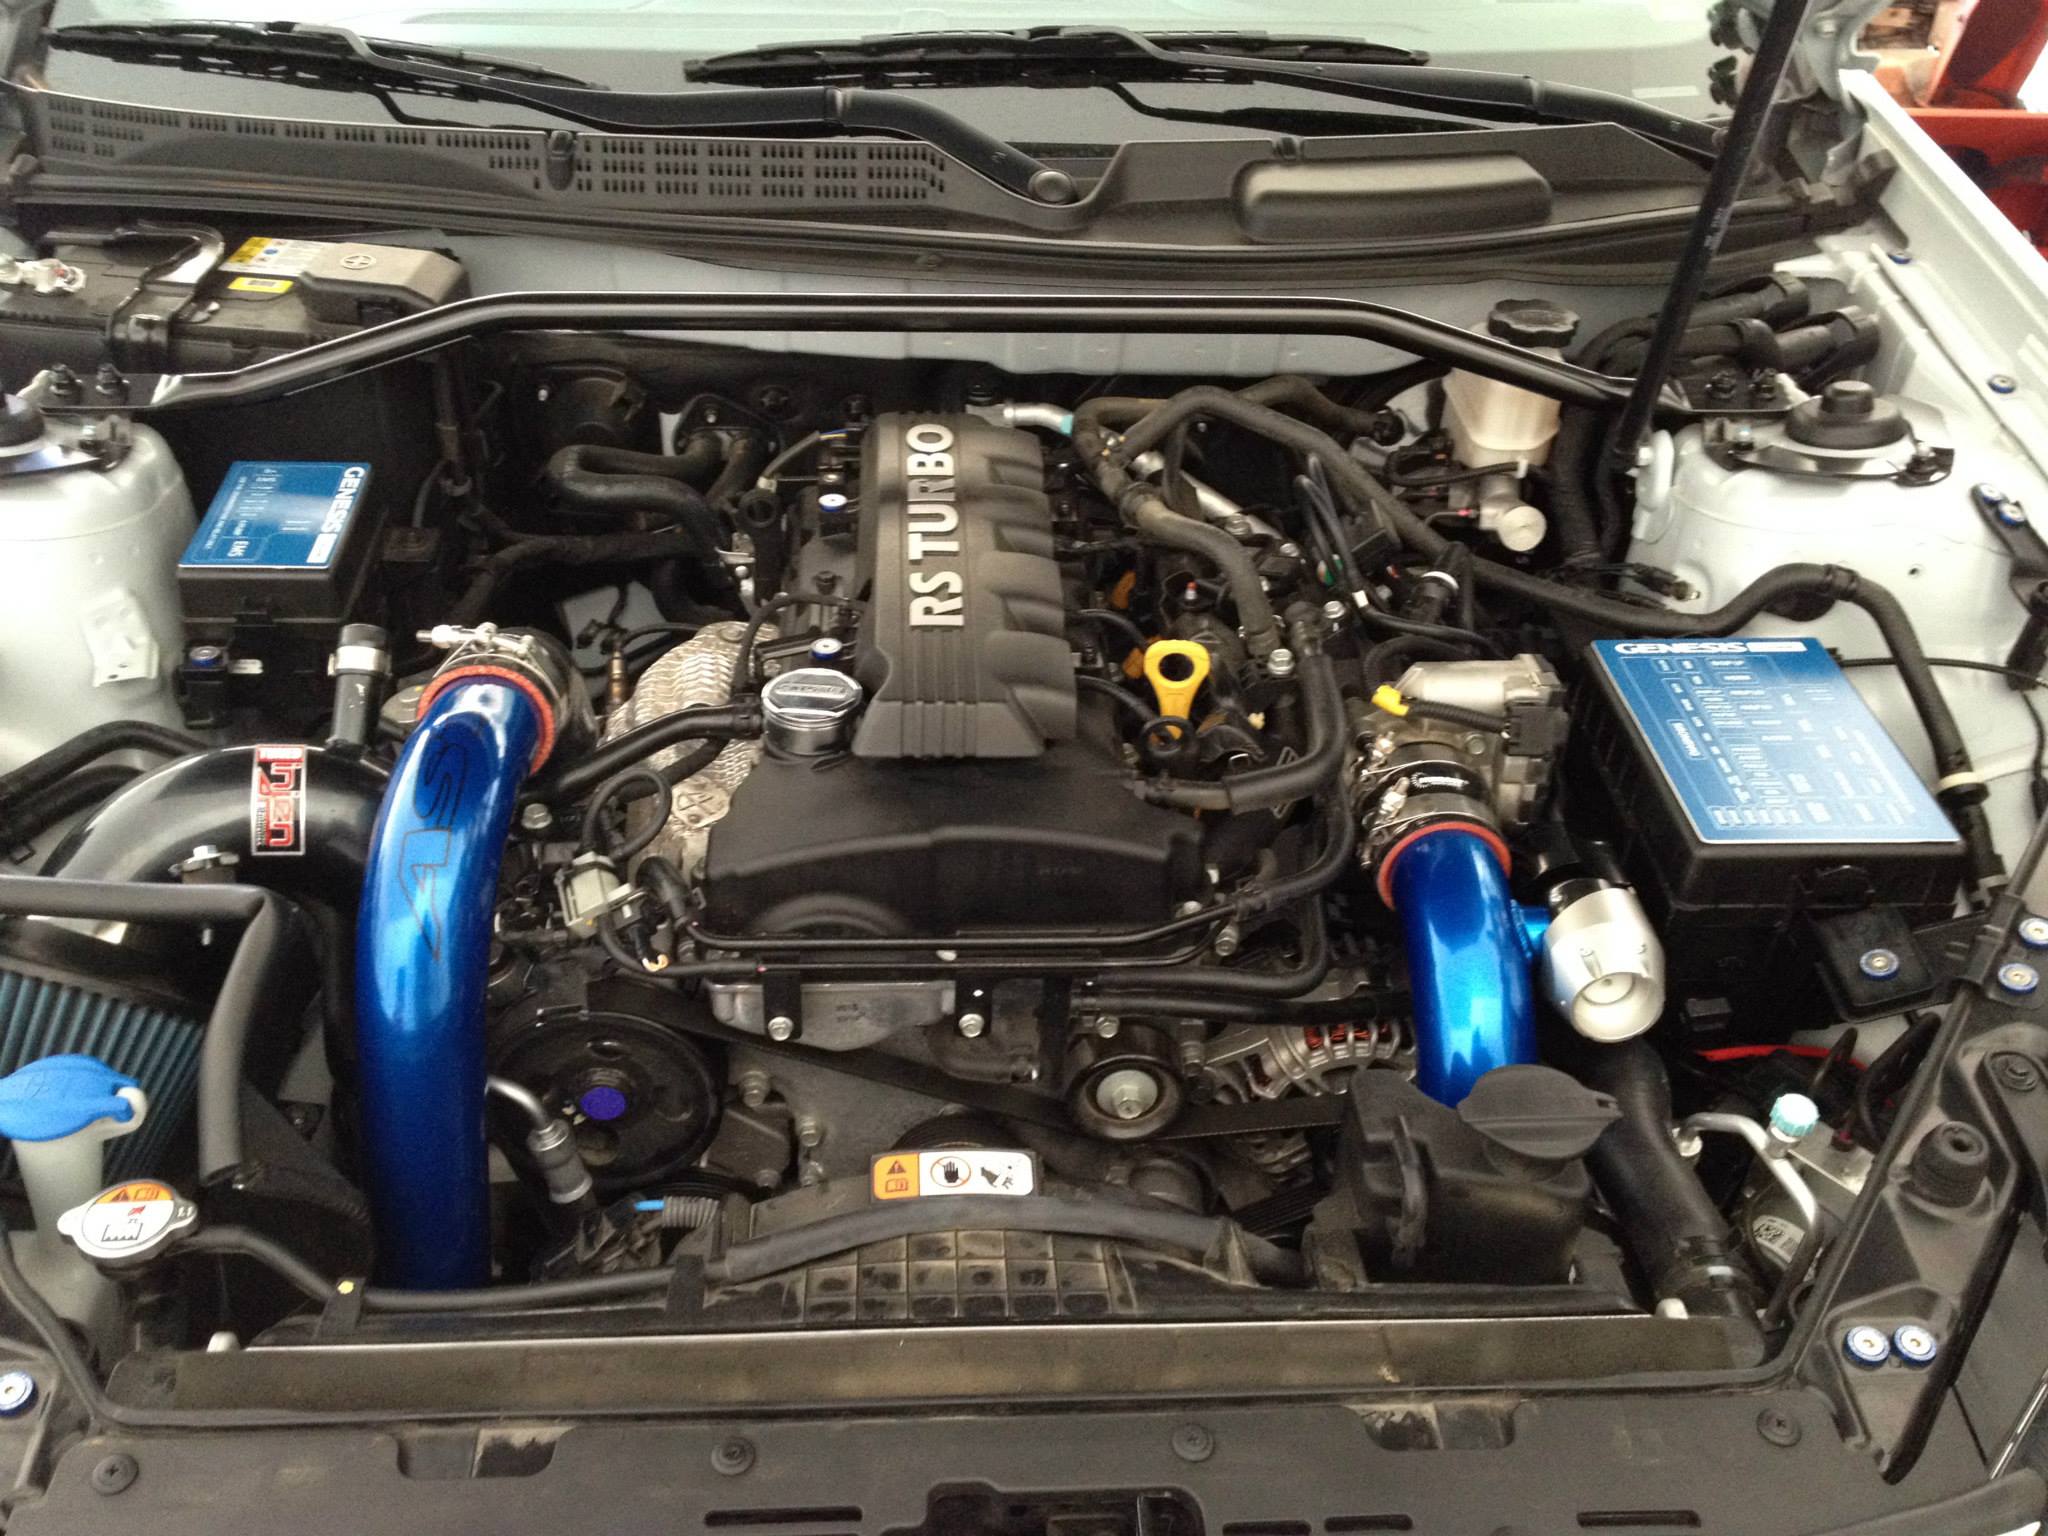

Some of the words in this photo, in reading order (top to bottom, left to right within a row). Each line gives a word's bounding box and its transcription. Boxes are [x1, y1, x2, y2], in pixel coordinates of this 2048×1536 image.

[320, 466, 366, 533] GENESIS
[906, 423, 960, 561] TURBO
[908, 570, 965, 626] RS
[1615, 641, 1748, 655] GENESIS
